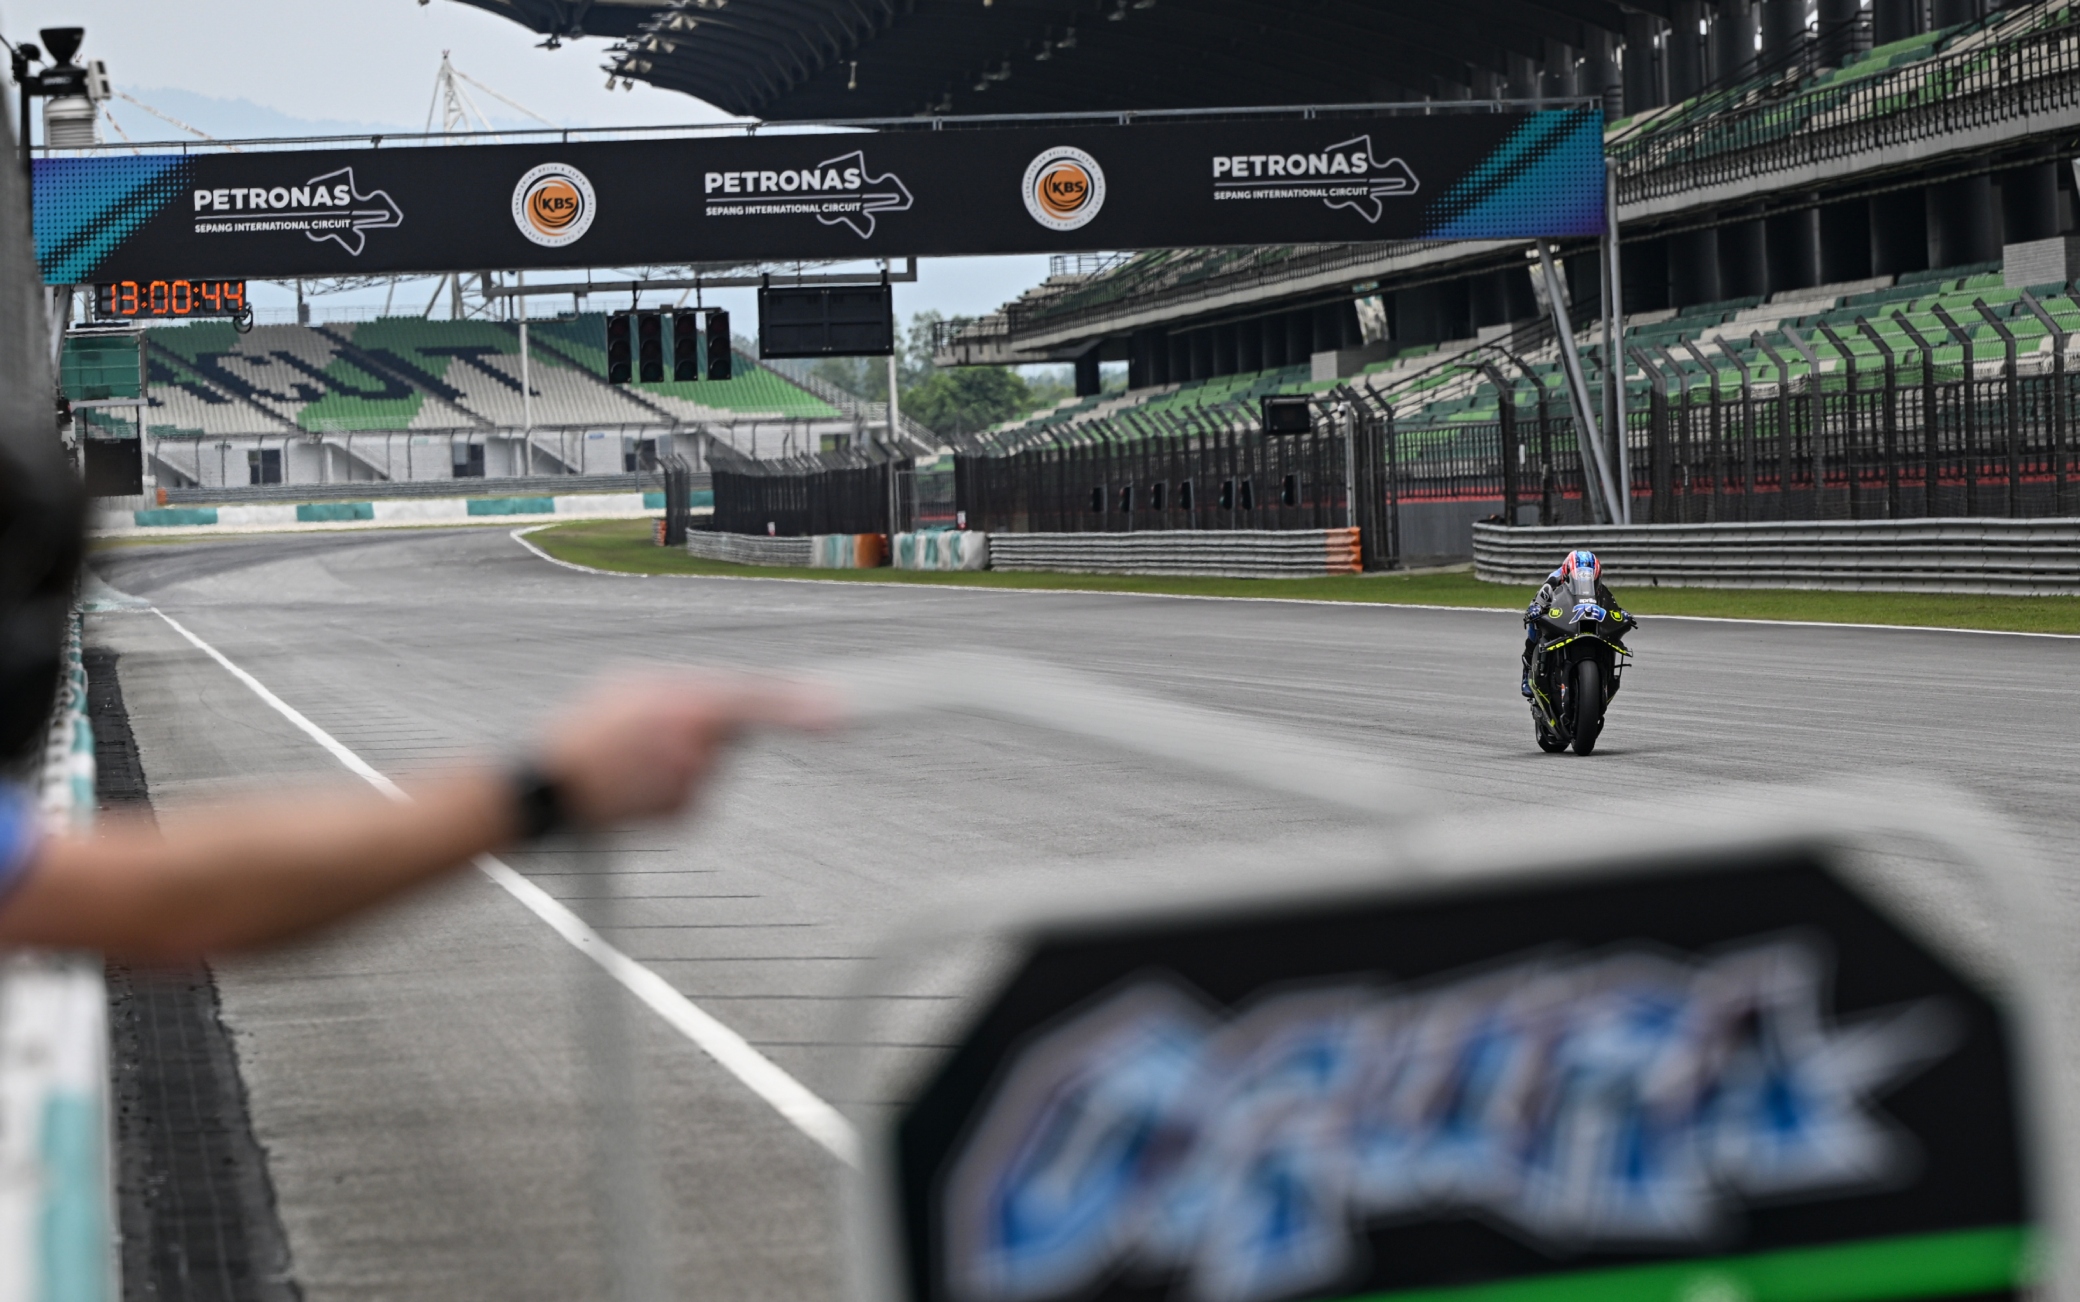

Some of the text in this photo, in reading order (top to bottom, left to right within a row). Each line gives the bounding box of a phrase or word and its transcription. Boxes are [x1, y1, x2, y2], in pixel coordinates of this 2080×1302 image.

[1213, 153, 1368, 177] PETRONAS
[705, 168, 862, 194] PETRONAS
[1052, 181, 1084, 196] KBS
[194, 185, 350, 212] PETRONAS
[1214, 187, 1368, 200] SEPANG INTERNATIONAL CIRCUIT
[542, 197, 574, 213] KBS
[706, 202, 861, 216] SEPANG INTERNATIONAL CIRCUIT
[195, 219, 350, 233] SEPANG INTERNATIONAL CIRCUIT
[111, 280, 243, 314] 13:00:44
